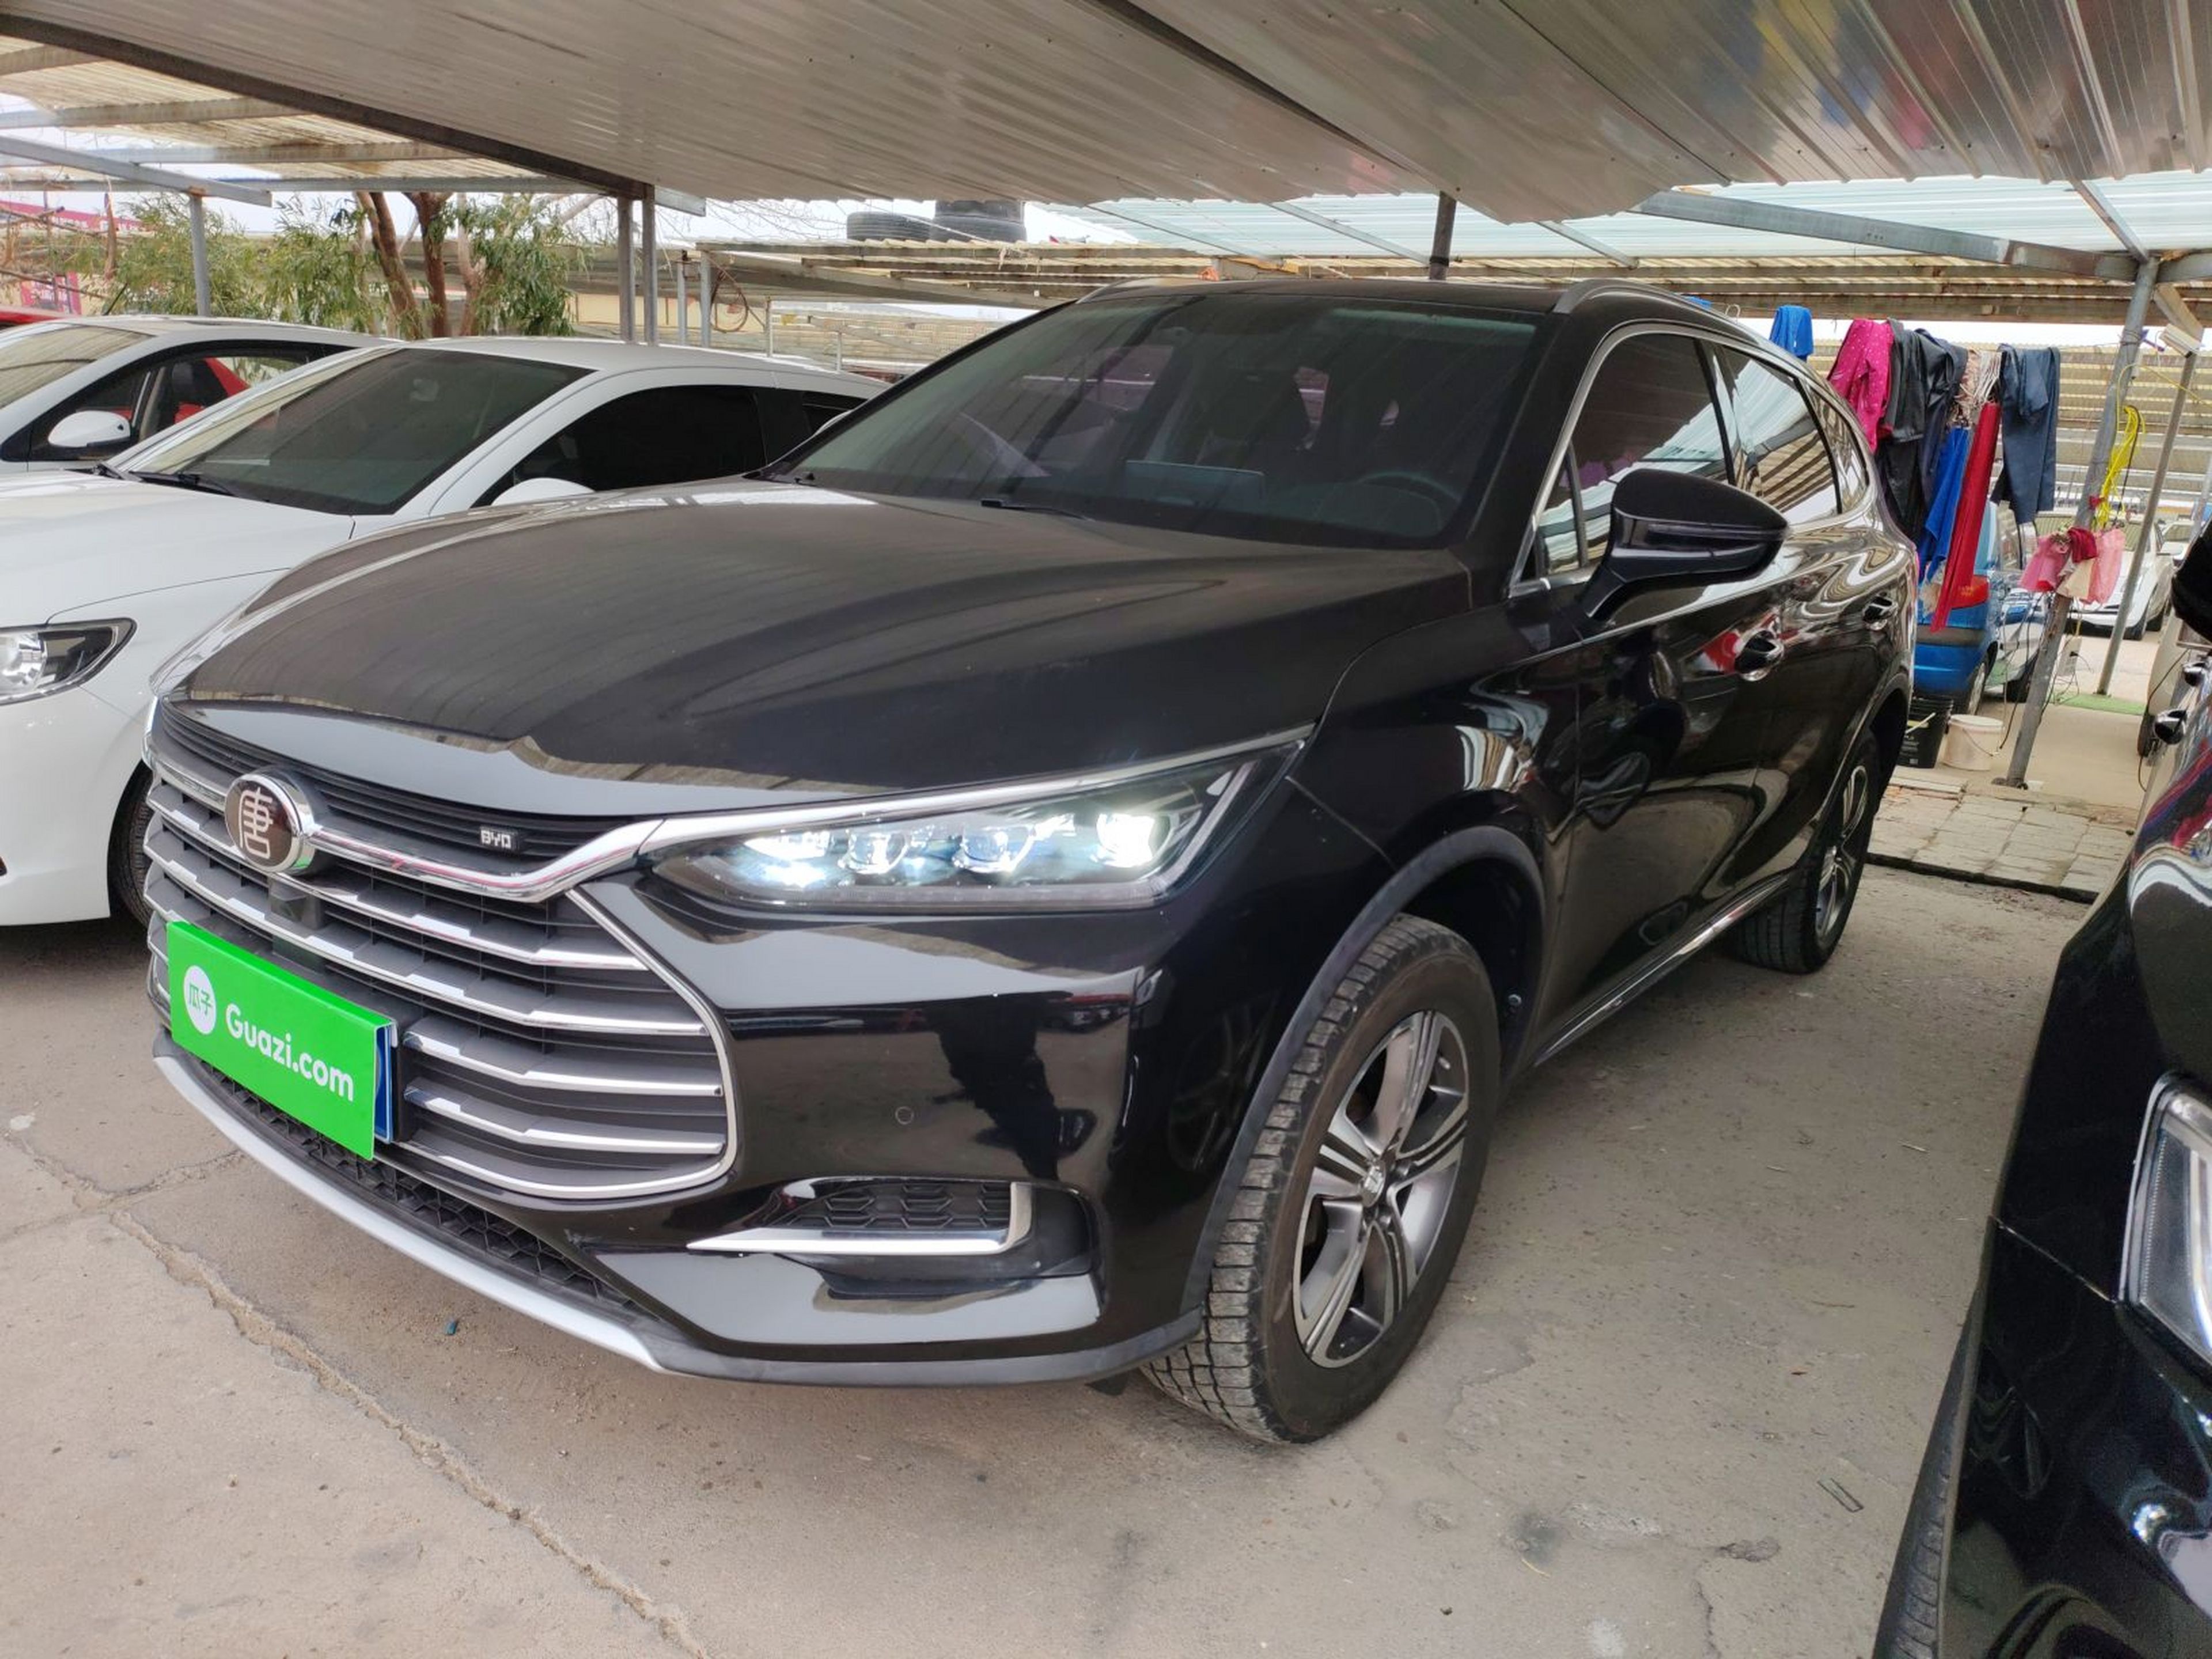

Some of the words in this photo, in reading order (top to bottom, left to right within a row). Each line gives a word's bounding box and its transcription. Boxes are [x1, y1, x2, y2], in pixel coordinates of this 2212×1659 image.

[480, 830, 512, 849] BYD
[189, 983, 212, 1015] 瓜子
[226, 1003, 354, 1102] Guazi.com
